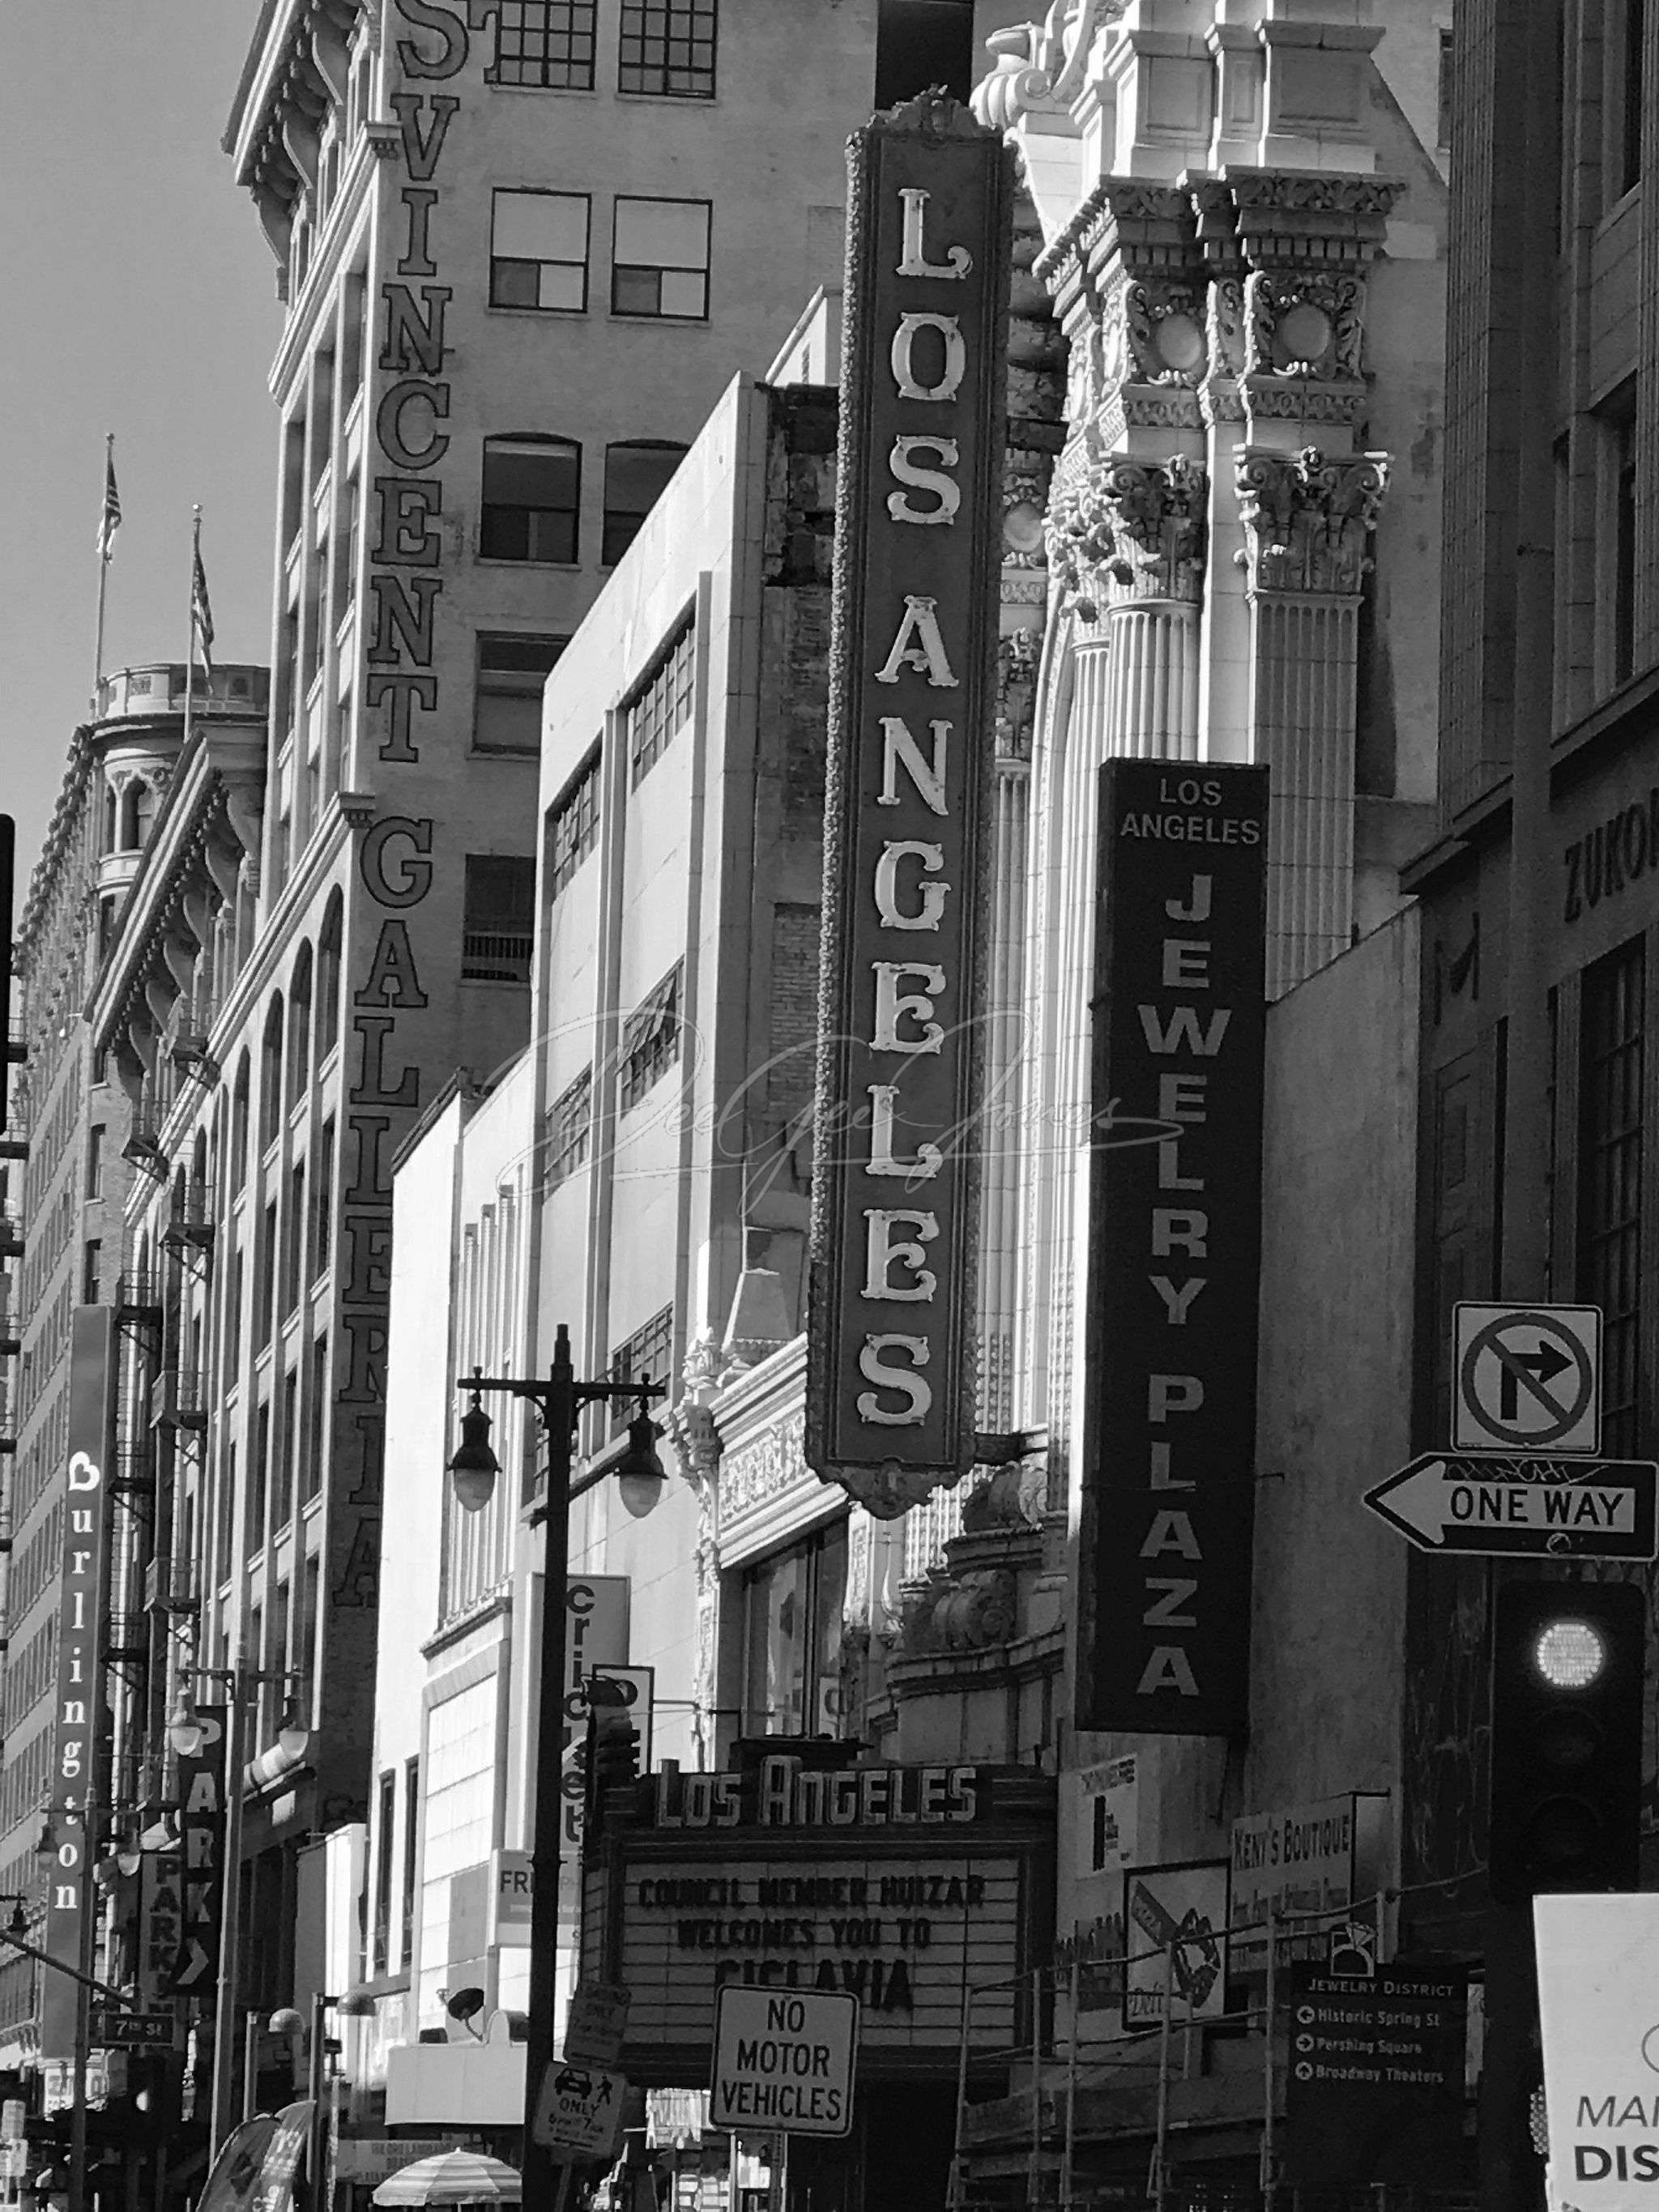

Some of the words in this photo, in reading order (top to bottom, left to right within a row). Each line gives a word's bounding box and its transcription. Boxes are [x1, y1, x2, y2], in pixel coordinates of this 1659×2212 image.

[888, 188, 973, 525] LOS
[365, 93, 461, 765] VINCENT
[1159, 778, 1223, 807] LOS
[1120, 812, 1261, 846] ANGELES
[857, 594, 959, 1426] ANGELES
[1137, 874, 1233, 1328] JEWELRY
[1450, 1485, 1529, 1523] ONE
[1544, 1490, 1624, 1527] WAY
[1137, 1374, 1205, 1696] PLAZA
[54, 1451, 102, 1910] Burlington
[657, 1758, 741, 1828] LOS
[185, 1717, 223, 1924] PARK
[638, 1877, 746, 1908] COUNCIL
[758, 1877, 868, 1907] MEMBER
[880, 1874, 986, 1908] HUIZAR
[677, 1918, 816, 1950] WELCOMES
[829, 1917, 881, 1949] YOU
[896, 1917, 932, 1949] TO
[1307, 1978, 1377, 1993] JEWELRY
[1383, 1980, 1455, 1997] DISTRICT
[767, 1998, 805, 2033] NO
[1317, 2008, 1374, 2025] Historic
[1377, 2010, 1422, 2029] Spring
[736, 2038, 830, 2078] MOTOR
[1316, 2036, 1375, 2056] Pershing
[1377, 2039, 1422, 2056] Square
[1316, 2064, 1381, 2083] Broadway
[1385, 2066, 1446, 2084] Theaters
[560, 2097, 600, 2117] ONLY
[722, 2079, 842, 2121] VEHICLES
[1576, 2095, 1659, 2128] MA
[1574, 2144, 1659, 2182] DIS
